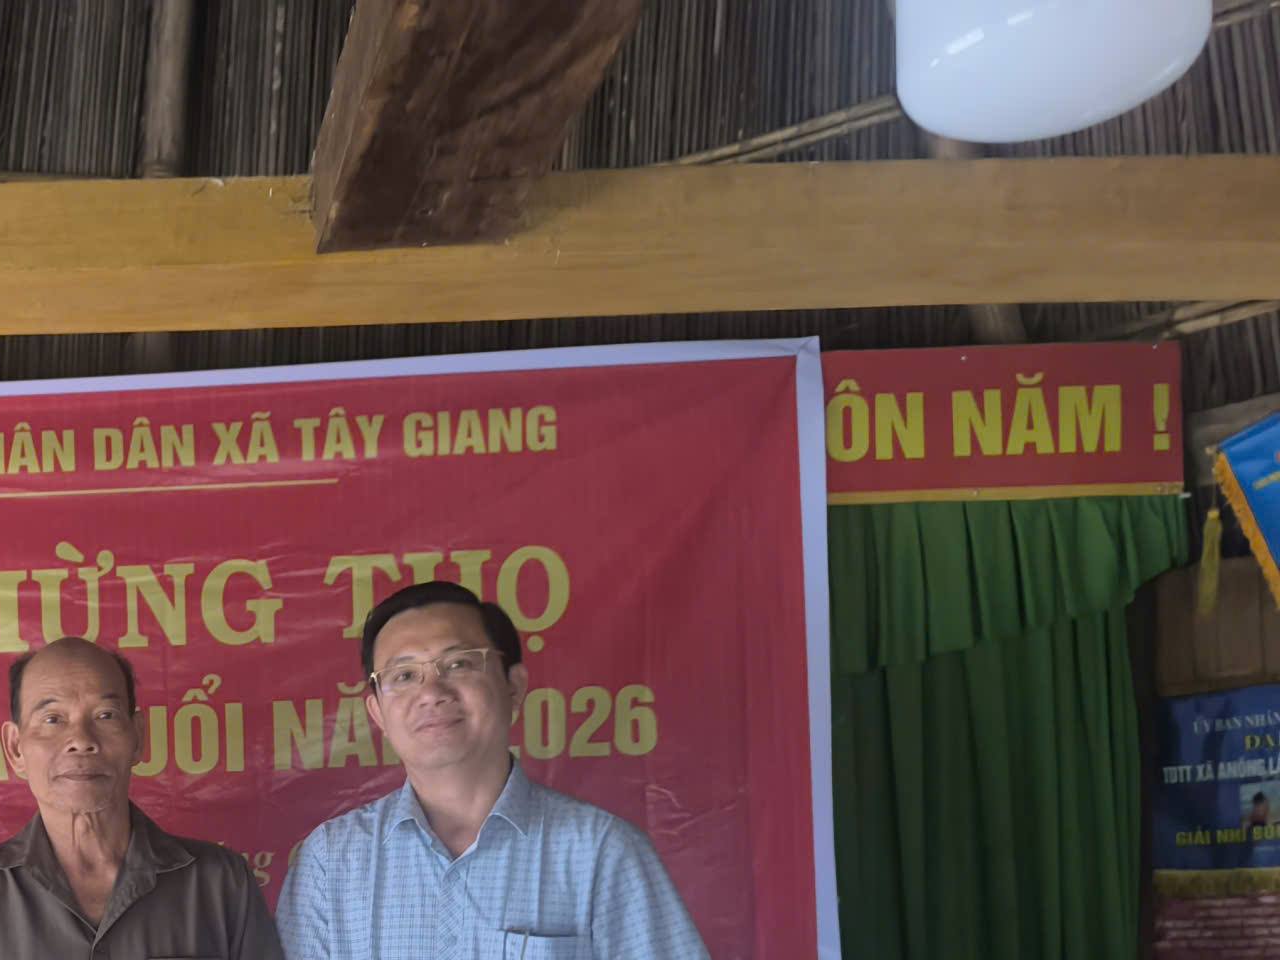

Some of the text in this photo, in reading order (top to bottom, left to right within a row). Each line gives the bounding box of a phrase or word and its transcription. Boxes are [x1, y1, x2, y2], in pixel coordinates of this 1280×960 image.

[93, 418, 195, 471] DÂN
[212, 411, 282, 465] XÃ
[294, 408, 386, 460] TÂY
[402, 405, 558, 457] GIANG
[952, 372, 1122, 457] NĂM
[1153, 384, 1171, 451] !
[131, 674, 246, 777] UỔI
[272, 681, 402, 772] NĂ
[508, 684, 658, 761] 026
